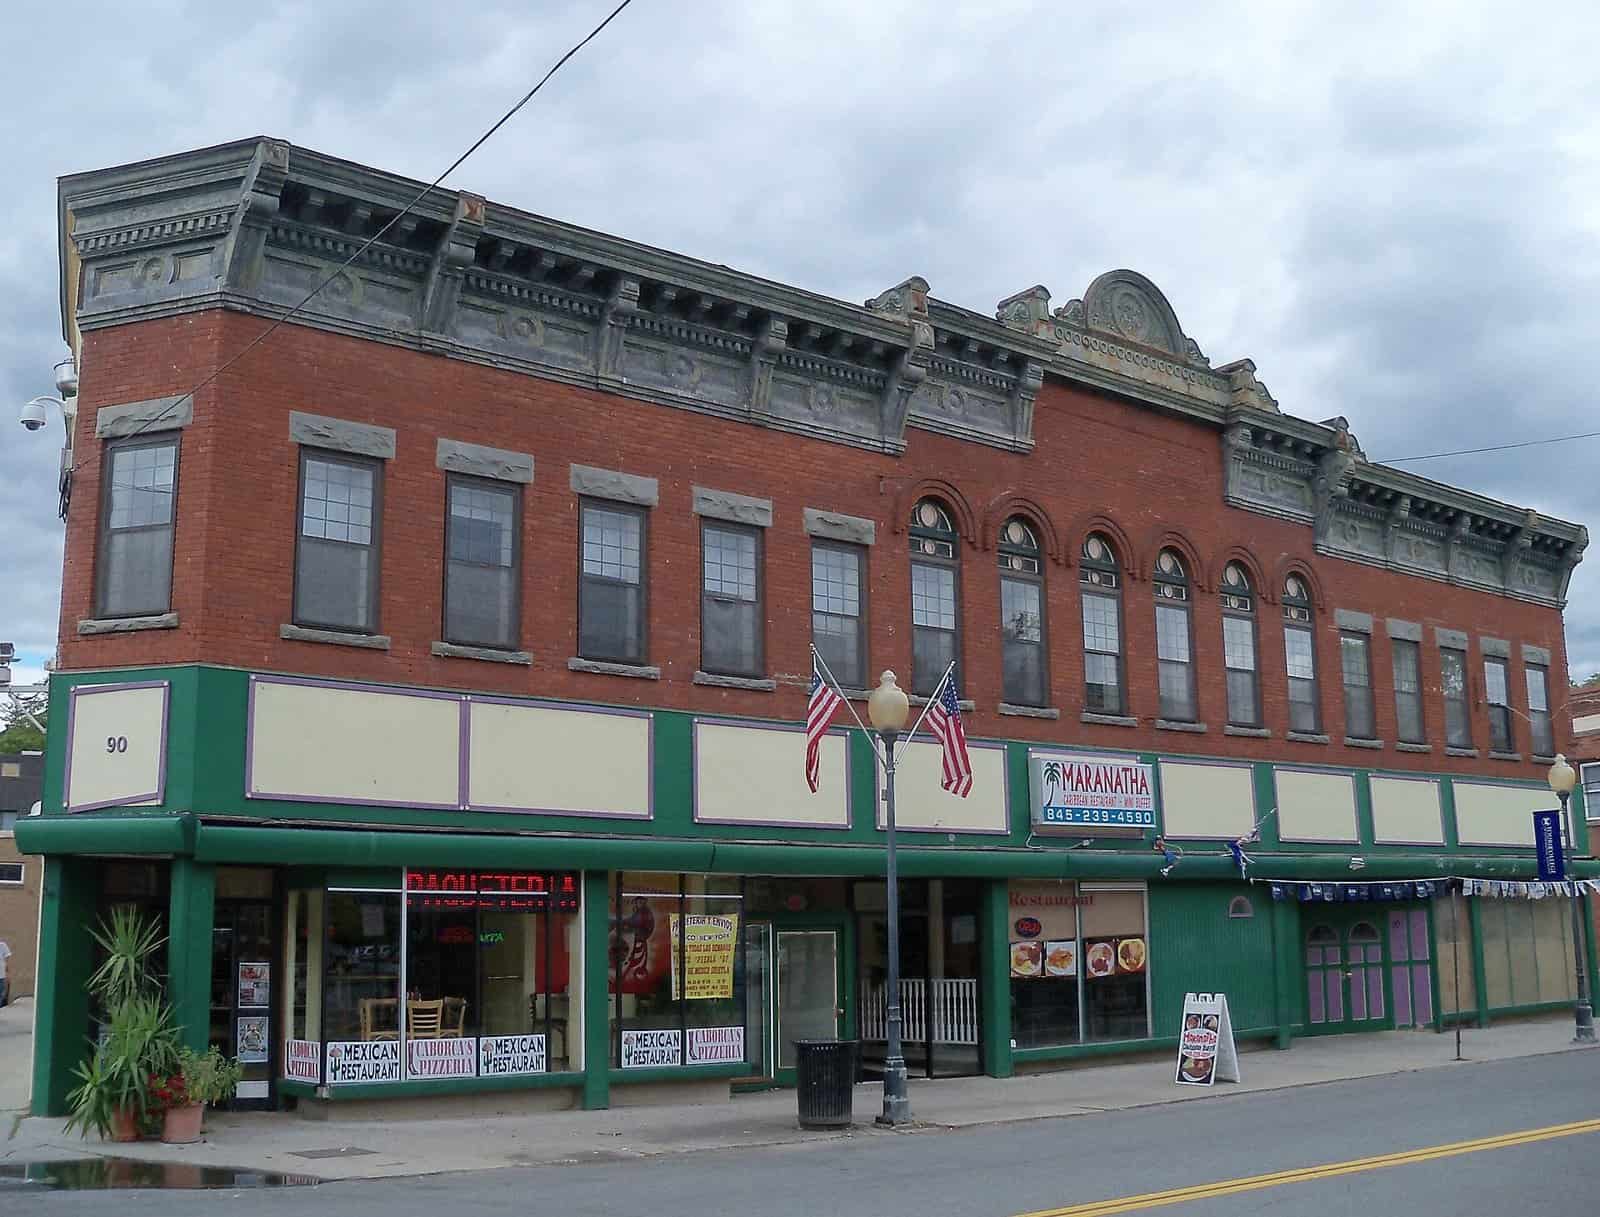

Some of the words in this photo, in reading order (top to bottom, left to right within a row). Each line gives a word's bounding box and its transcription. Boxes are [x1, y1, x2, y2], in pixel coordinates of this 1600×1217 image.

[106, 736, 128, 753] 90
[1061, 762, 1149, 795] MARANATHA
[1047, 808, 1152, 824] 845-239-4590
[495, 1036, 545, 1055] MEXICAN
[635, 1032, 680, 1048] MEXICAN
[344, 1042, 399, 1061] MEXICAN
[633, 1048, 681, 1066] RESTAURANT
[698, 1045, 742, 1060] PIZZERIA
[341, 1061, 400, 1081] RESTAURANT
[419, 1058, 473, 1076] PIZZERIA
[492, 1054, 546, 1074] RESTAURANT
